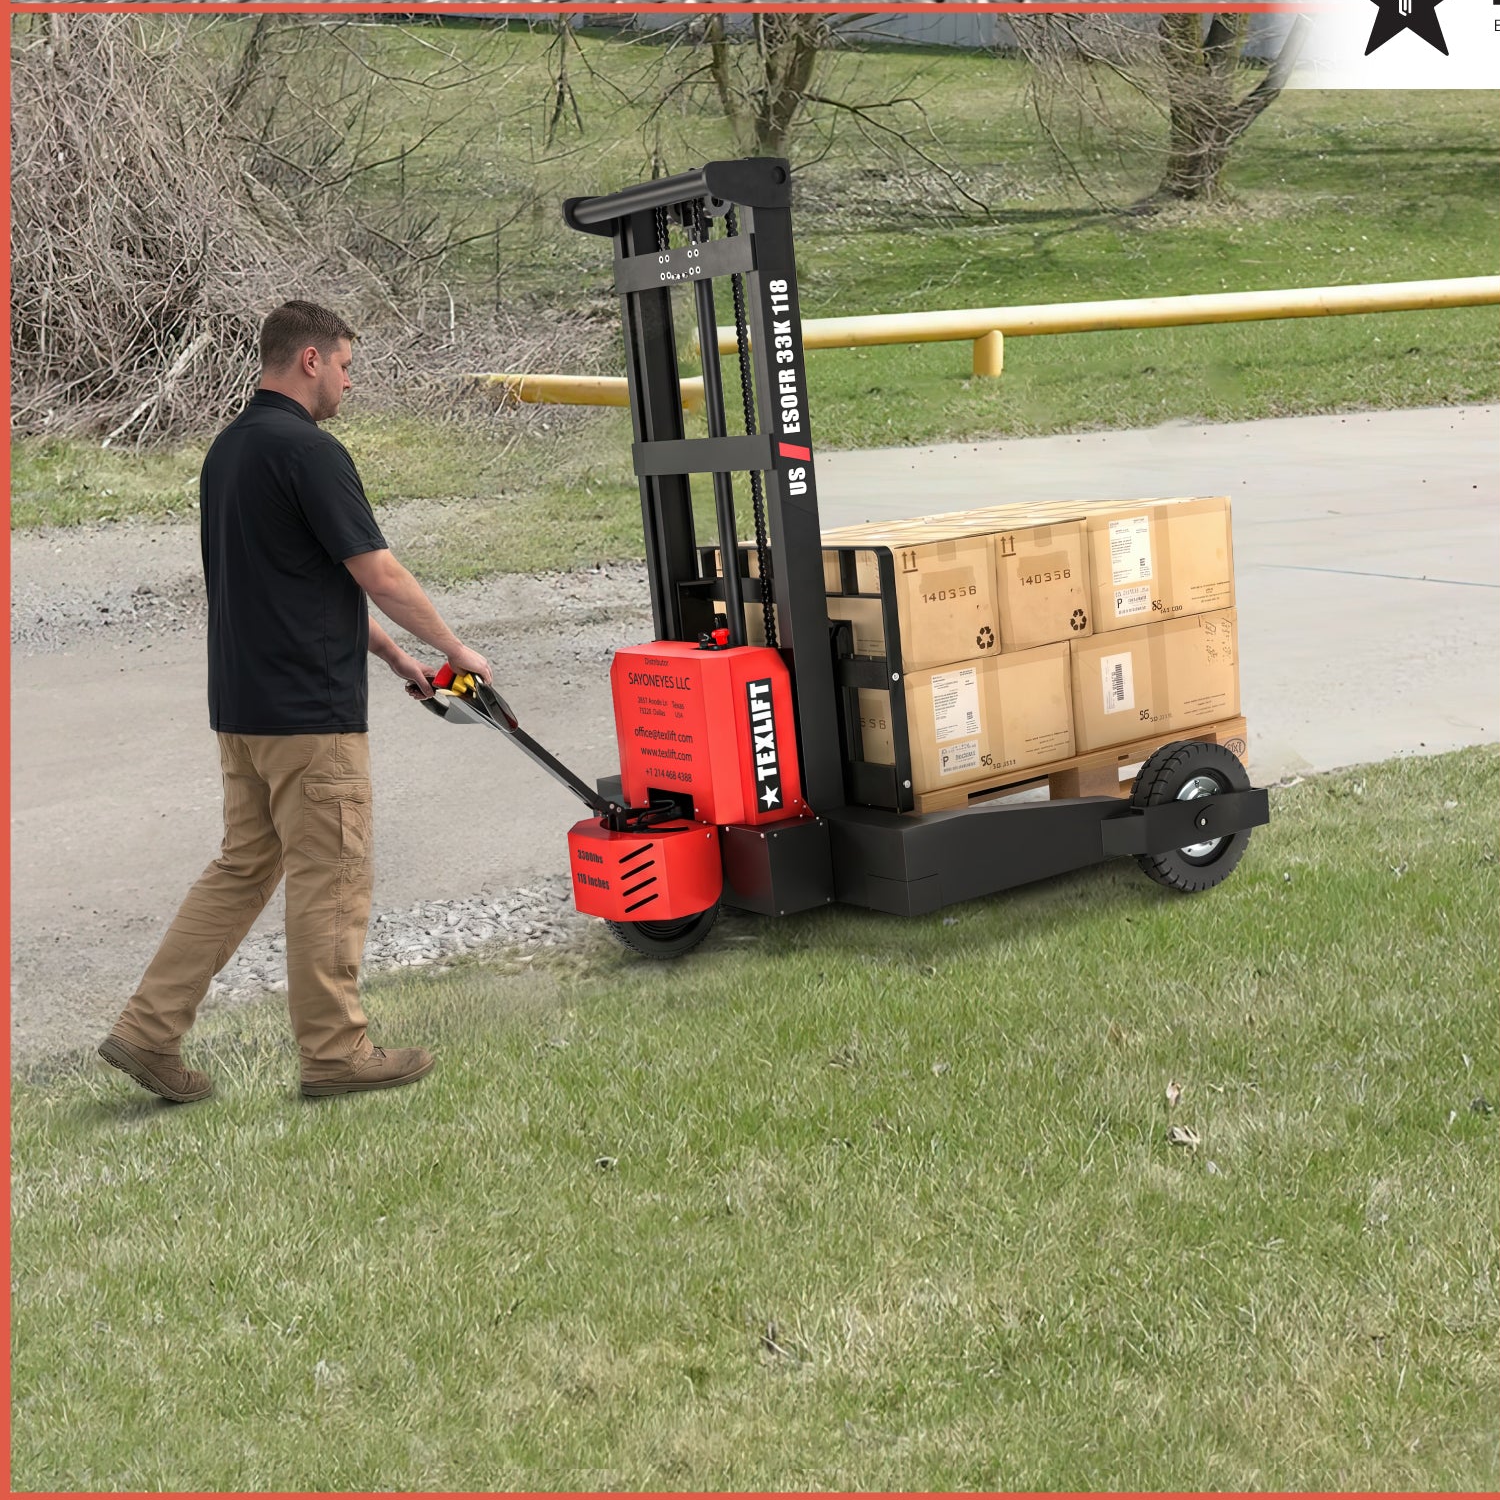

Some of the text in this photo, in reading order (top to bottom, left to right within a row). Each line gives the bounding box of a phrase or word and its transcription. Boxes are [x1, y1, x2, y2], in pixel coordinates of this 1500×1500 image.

[769, 279, 808, 496] US ESOFR 33K 118
[1020, 569, 1071, 587] 140358
[922, 586, 977, 604] 140358
[628, 672, 691, 691] SAYONEYES LLC
[634, 726, 693, 744] office@texlift.com
[750, 683, 777, 781] TEXLIFT
[641, 747, 693, 762] www.texlift.com
[943, 756, 949, 767] P
[645, 767, 653, 777] +1
[654, 768, 665, 778] 214
